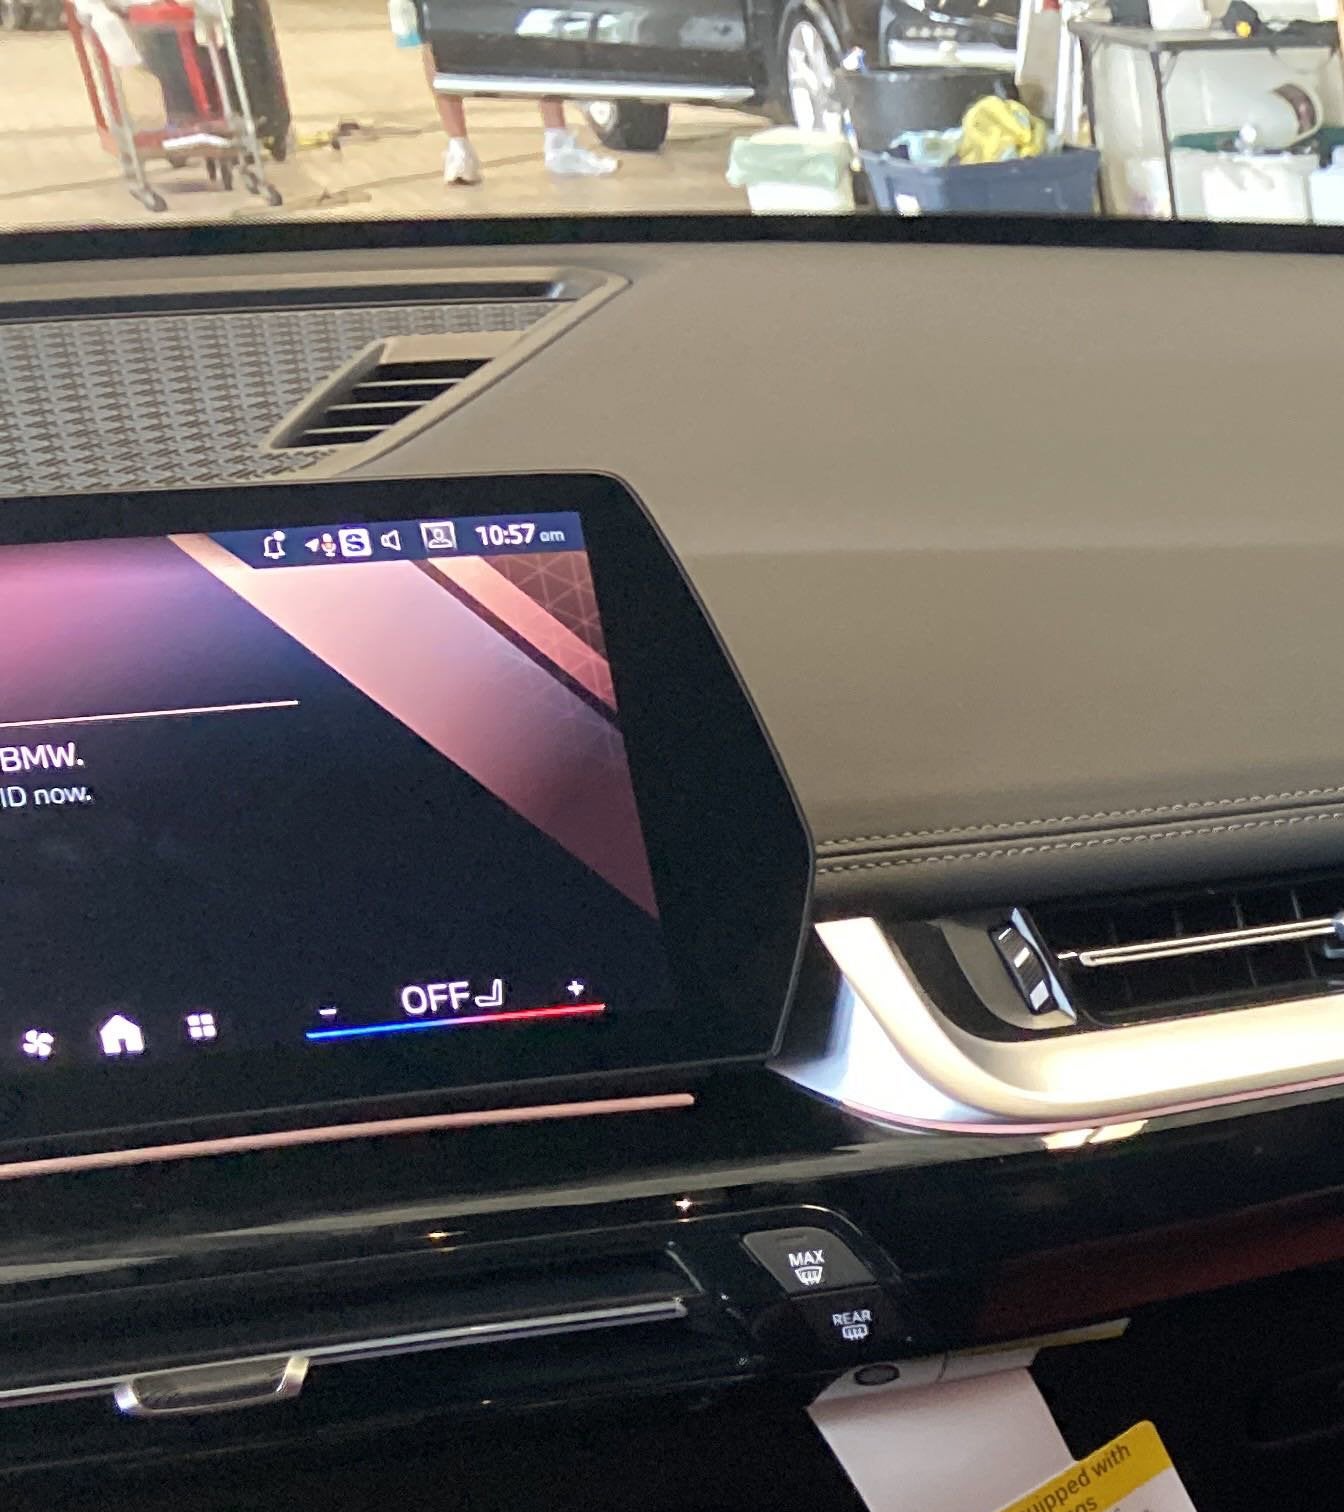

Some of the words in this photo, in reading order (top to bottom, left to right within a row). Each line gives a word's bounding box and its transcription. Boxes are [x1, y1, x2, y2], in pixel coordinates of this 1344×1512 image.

[475, 523, 535, 547] 10:57
[539, 529, 566, 543] am
[0, 742, 84, 772] BMW.
[0, 786, 27, 808] ID
[33, 786, 92, 805] now.
[401, 981, 470, 1015] OFF
[788, 1249, 825, 1268] MAX
[832, 1309, 873, 1326] REAR
[1088, 1441, 1131, 1478] with
